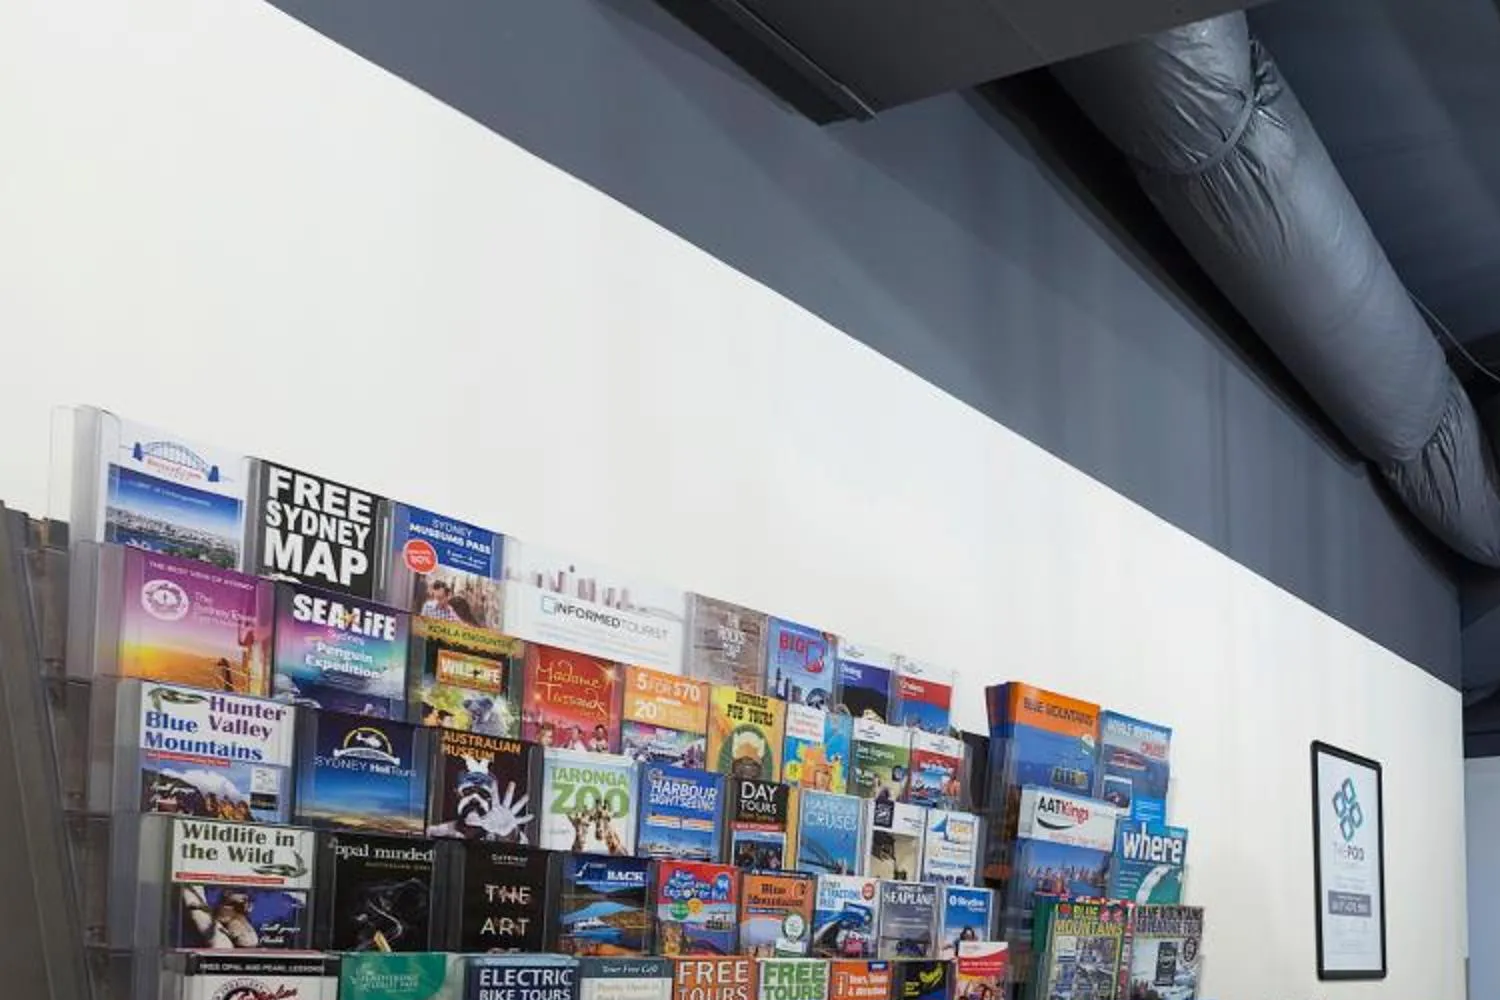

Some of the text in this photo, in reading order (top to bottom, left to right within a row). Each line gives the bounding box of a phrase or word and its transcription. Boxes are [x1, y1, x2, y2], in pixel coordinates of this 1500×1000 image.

[268, 467, 373, 524] FREE
[265, 500, 371, 550] SYDNEY
[263, 529, 369, 586] MAP
[209, 695, 287, 721] Hunter
[146, 711, 198, 735] Blue
[209, 715, 273, 741] Valley
[145, 731, 264, 762] Mountains
[442, 730, 522, 755] AUSTRALIAN
[442, 744, 495, 762] MUSEUM
[314, 756, 367, 773] SYDNEY
[553, 767, 629, 786] TARONGA
[551, 784, 630, 817] ZOO
[650, 780, 718, 801] HARBOUR
[741, 782, 778, 800] DAY
[740, 800, 778, 815] TOURS
[181, 821, 295, 848] Wildlife in
[1122, 822, 1183, 863] where
[181, 843, 275, 865] the Wild
[484, 884, 532, 905] THE
[480, 917, 531, 937] ART
[479, 968, 574, 987] ELECTRIC
[679, 960, 750, 985] FREE
[764, 962, 825, 985] FREE
